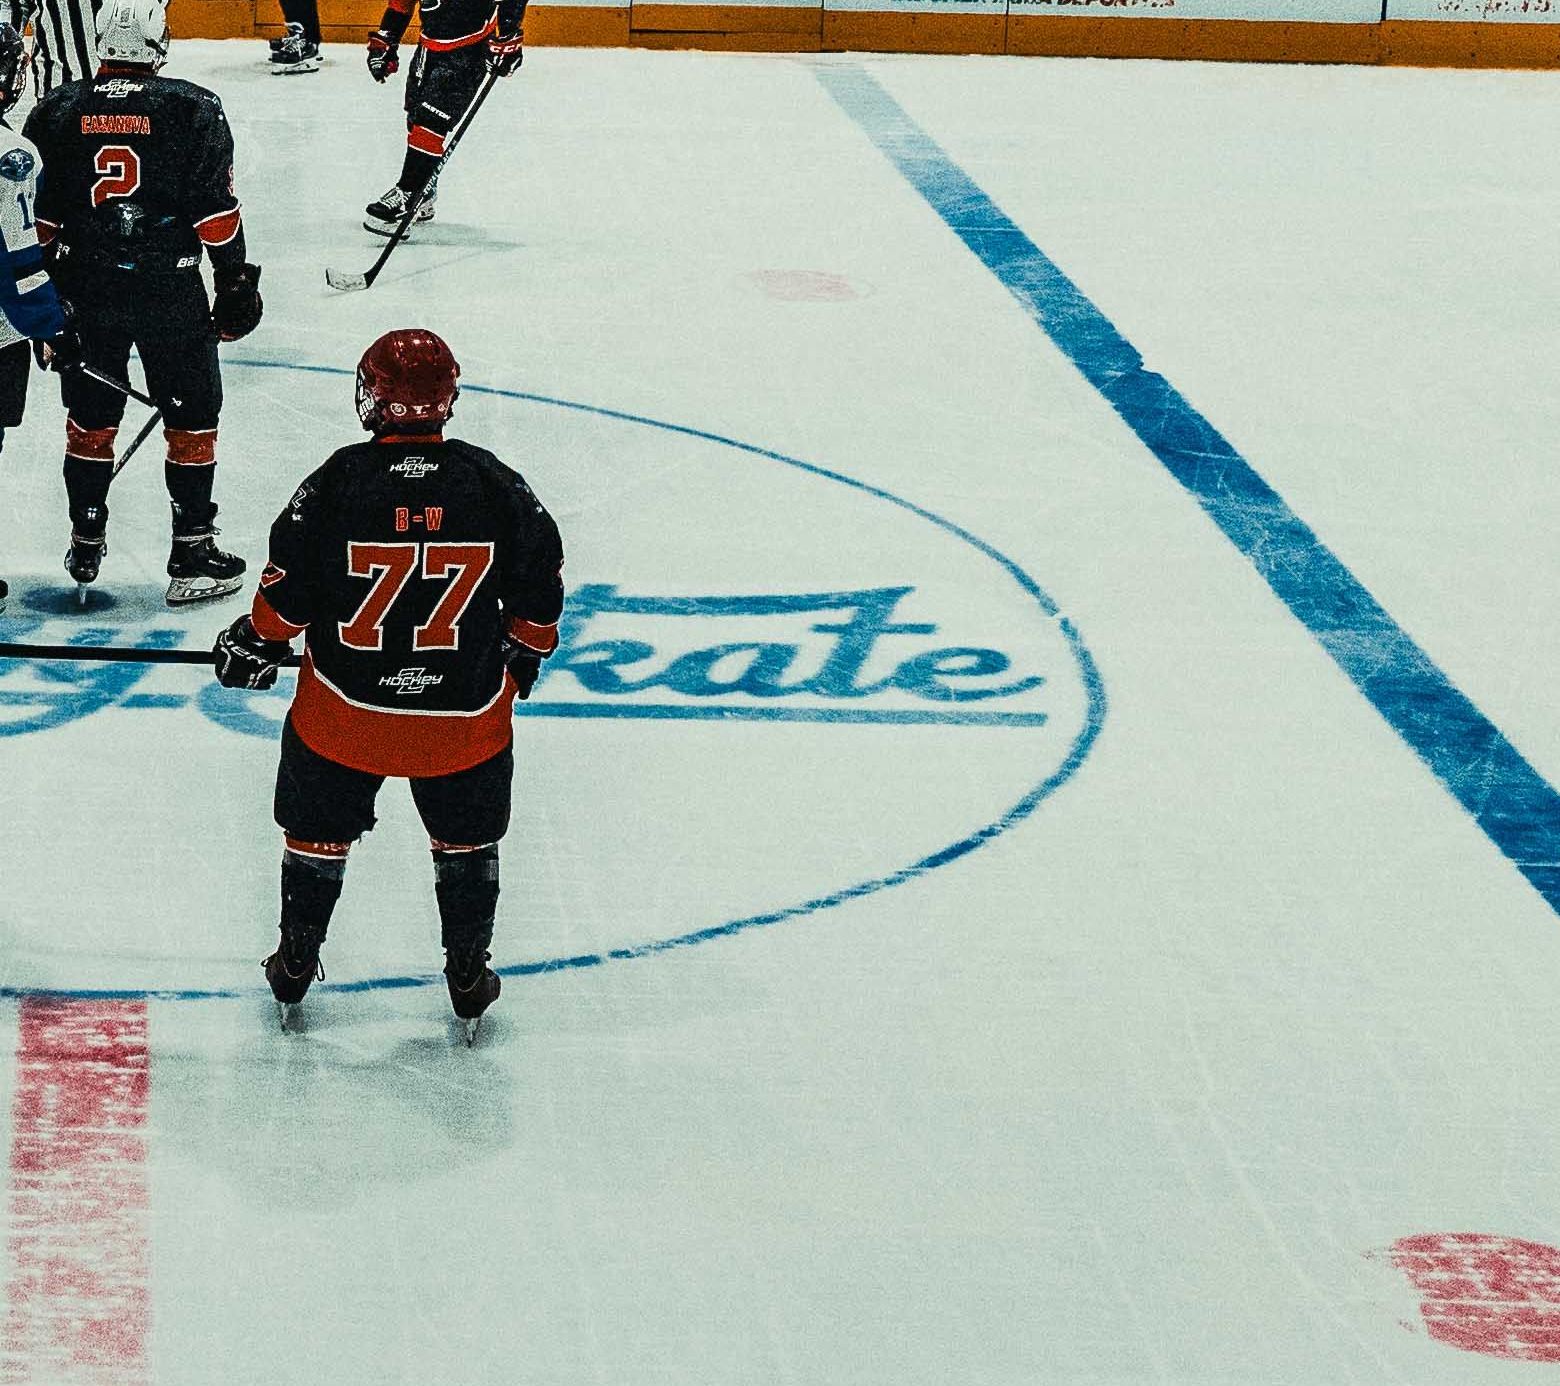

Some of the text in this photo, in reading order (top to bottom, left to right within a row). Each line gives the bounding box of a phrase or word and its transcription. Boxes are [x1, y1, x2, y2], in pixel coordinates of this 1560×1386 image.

[81, 114, 151, 135] CASANOVA
[90, 145, 141, 208] 2
[338, 541, 496, 652] 77
